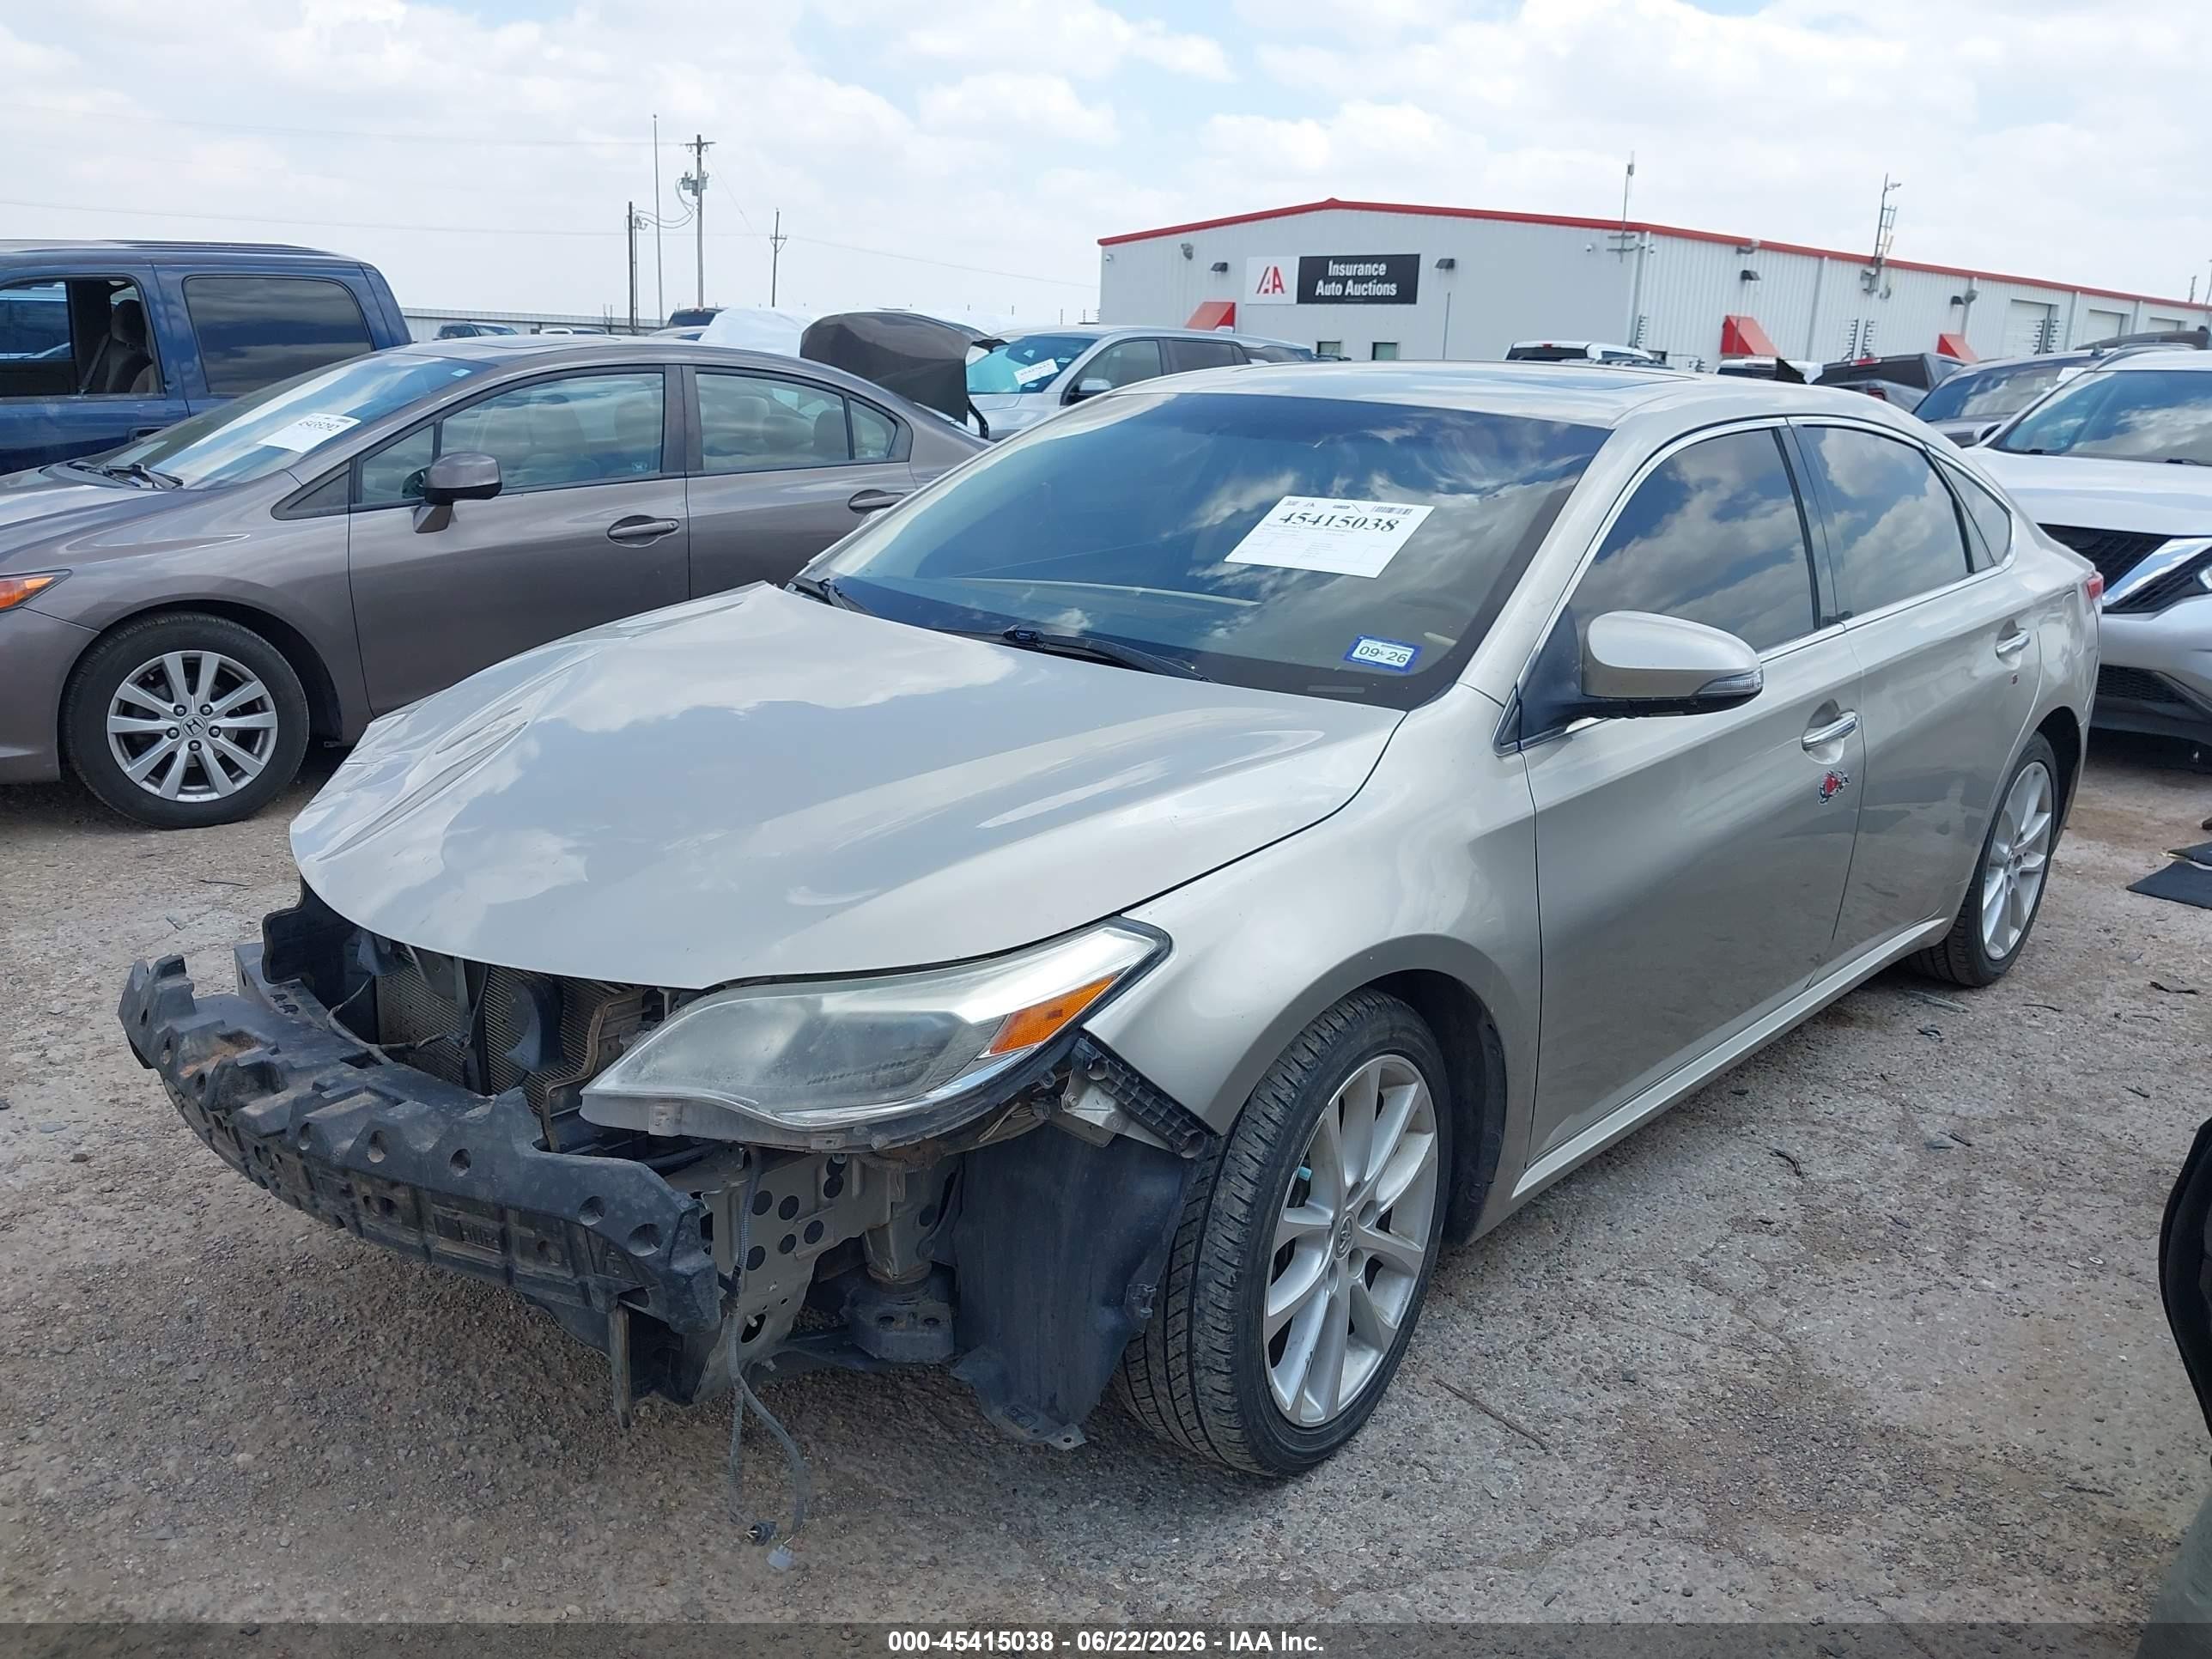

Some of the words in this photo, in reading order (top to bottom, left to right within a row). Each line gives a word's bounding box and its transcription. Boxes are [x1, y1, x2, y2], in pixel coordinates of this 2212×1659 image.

[1328, 260, 1387, 276] Insurance
[1315, 279, 1343, 296] Auto
[1345, 279, 1398, 296] Auctions
[1278, 512, 1400, 532] 45415038
[1358, 646, 1380, 658] 09
[1386, 651, 1409, 663] 26
